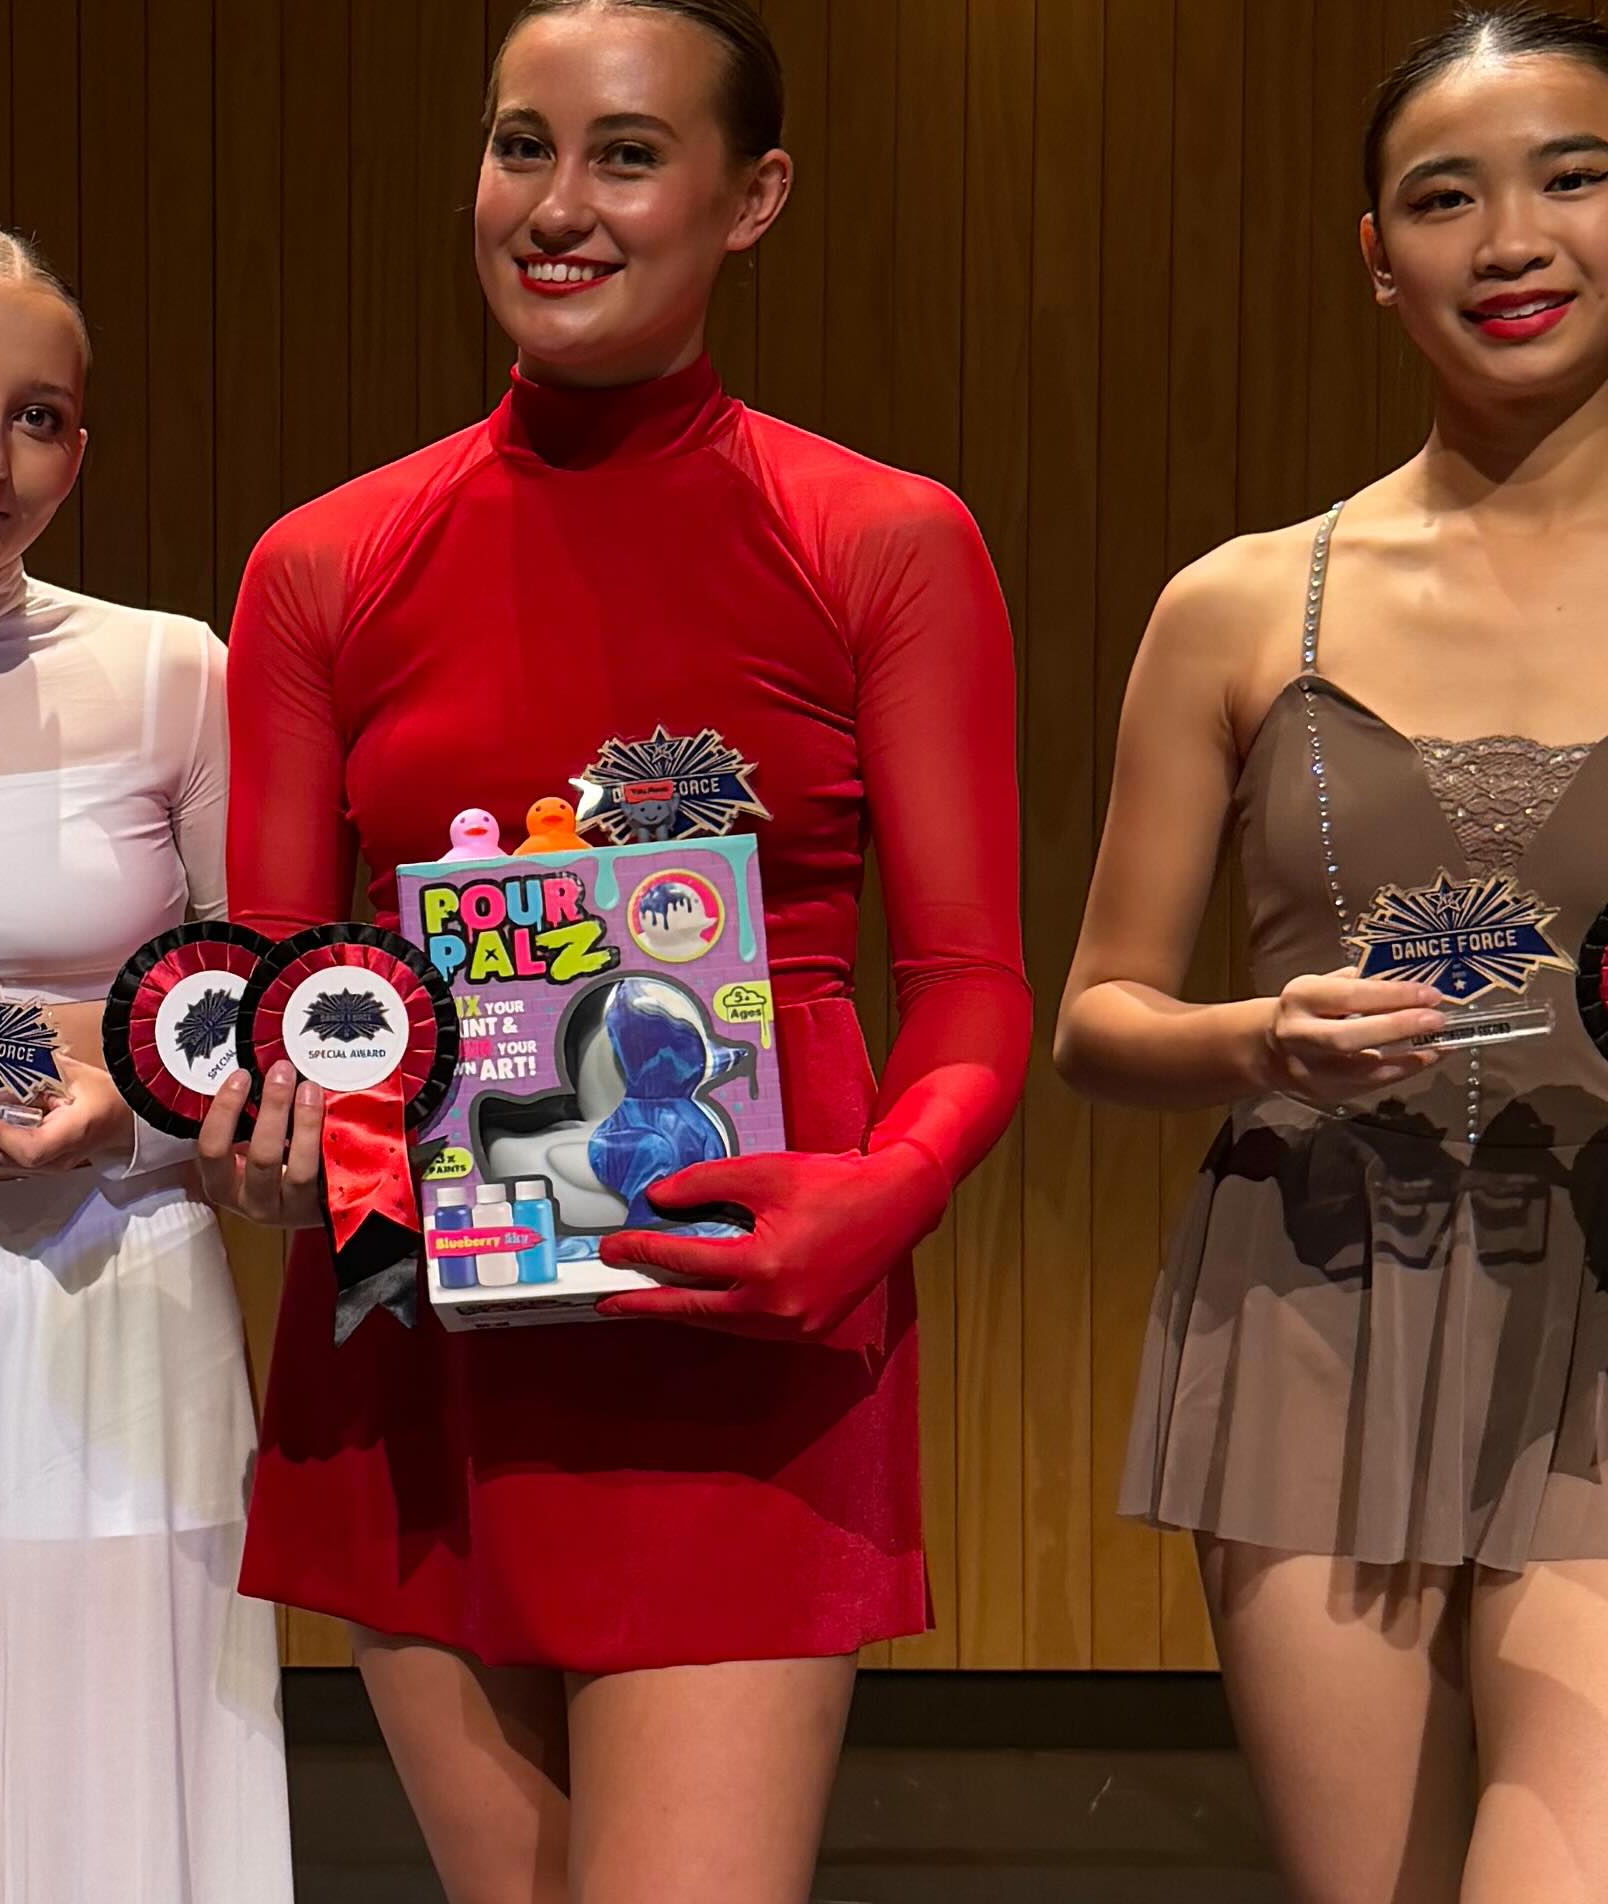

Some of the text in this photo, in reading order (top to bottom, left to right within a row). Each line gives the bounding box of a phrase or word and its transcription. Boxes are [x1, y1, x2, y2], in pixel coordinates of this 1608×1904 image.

[423, 877, 583, 934] POUR
[428, 920, 612, 982] PALZ
[1391, 930, 1518, 961] DANCE FORCE
[455, 994, 525, 1018] IX YOUR
[460, 1016, 519, 1038] INT &
[308, 1048, 387, 1059] SPECIAL AWARD
[497, 1040, 537, 1056] YOUR
[480, 1055, 537, 1081] ART!
[428, 1163, 467, 1175] PAINTS
[434, 1236, 501, 1250] Blueberry
